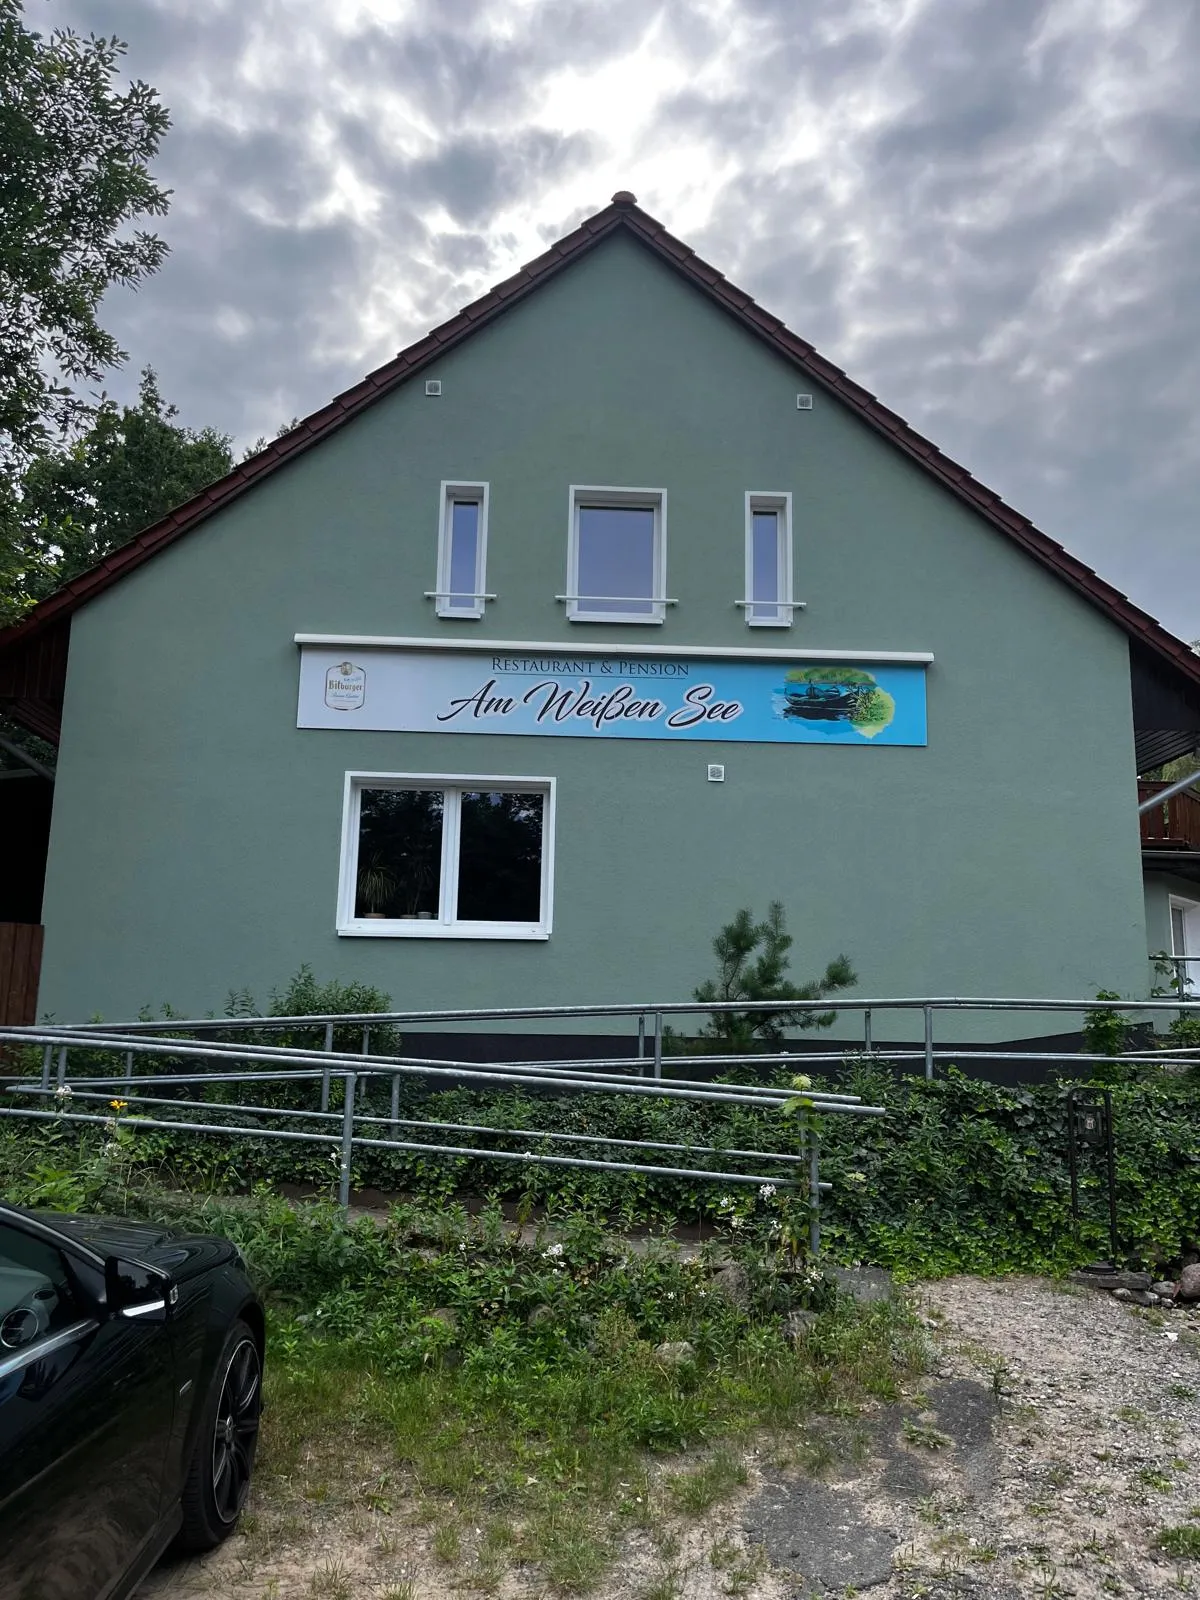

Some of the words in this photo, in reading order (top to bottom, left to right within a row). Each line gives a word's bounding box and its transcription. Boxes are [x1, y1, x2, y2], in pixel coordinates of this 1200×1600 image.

[492, 657, 593, 674] RESTAURANT
[600, 660, 613, 674] &
[619, 660, 689, 676] PENSION
[436, 679, 516, 721] Am
[523, 681, 662, 728] Weißen
[667, 686, 740, 727] See
